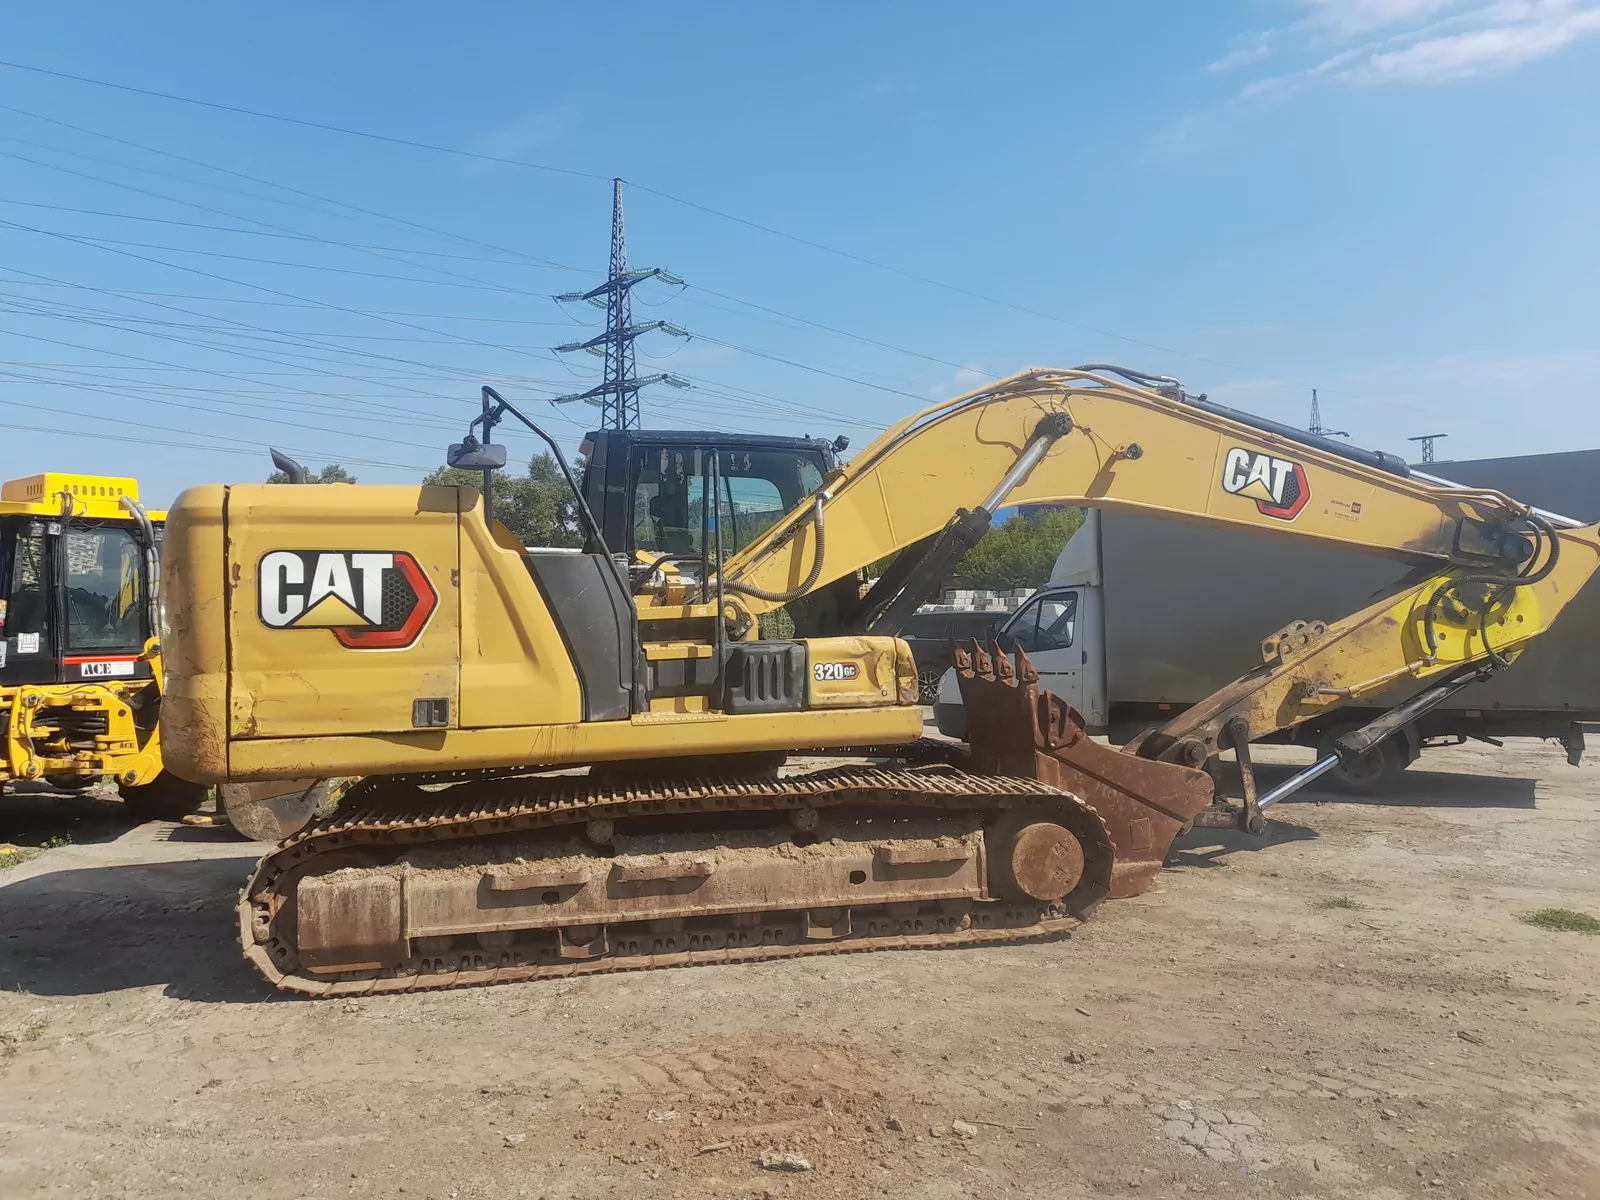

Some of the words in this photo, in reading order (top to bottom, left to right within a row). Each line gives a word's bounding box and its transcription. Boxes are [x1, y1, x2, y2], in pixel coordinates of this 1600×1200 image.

[1223, 448, 1293, 504] CAT
[261, 551, 393, 626] CAT
[84, 663, 111, 675] ACE
[814, 663, 843, 681] 320
[844, 667, 855, 676] GC
